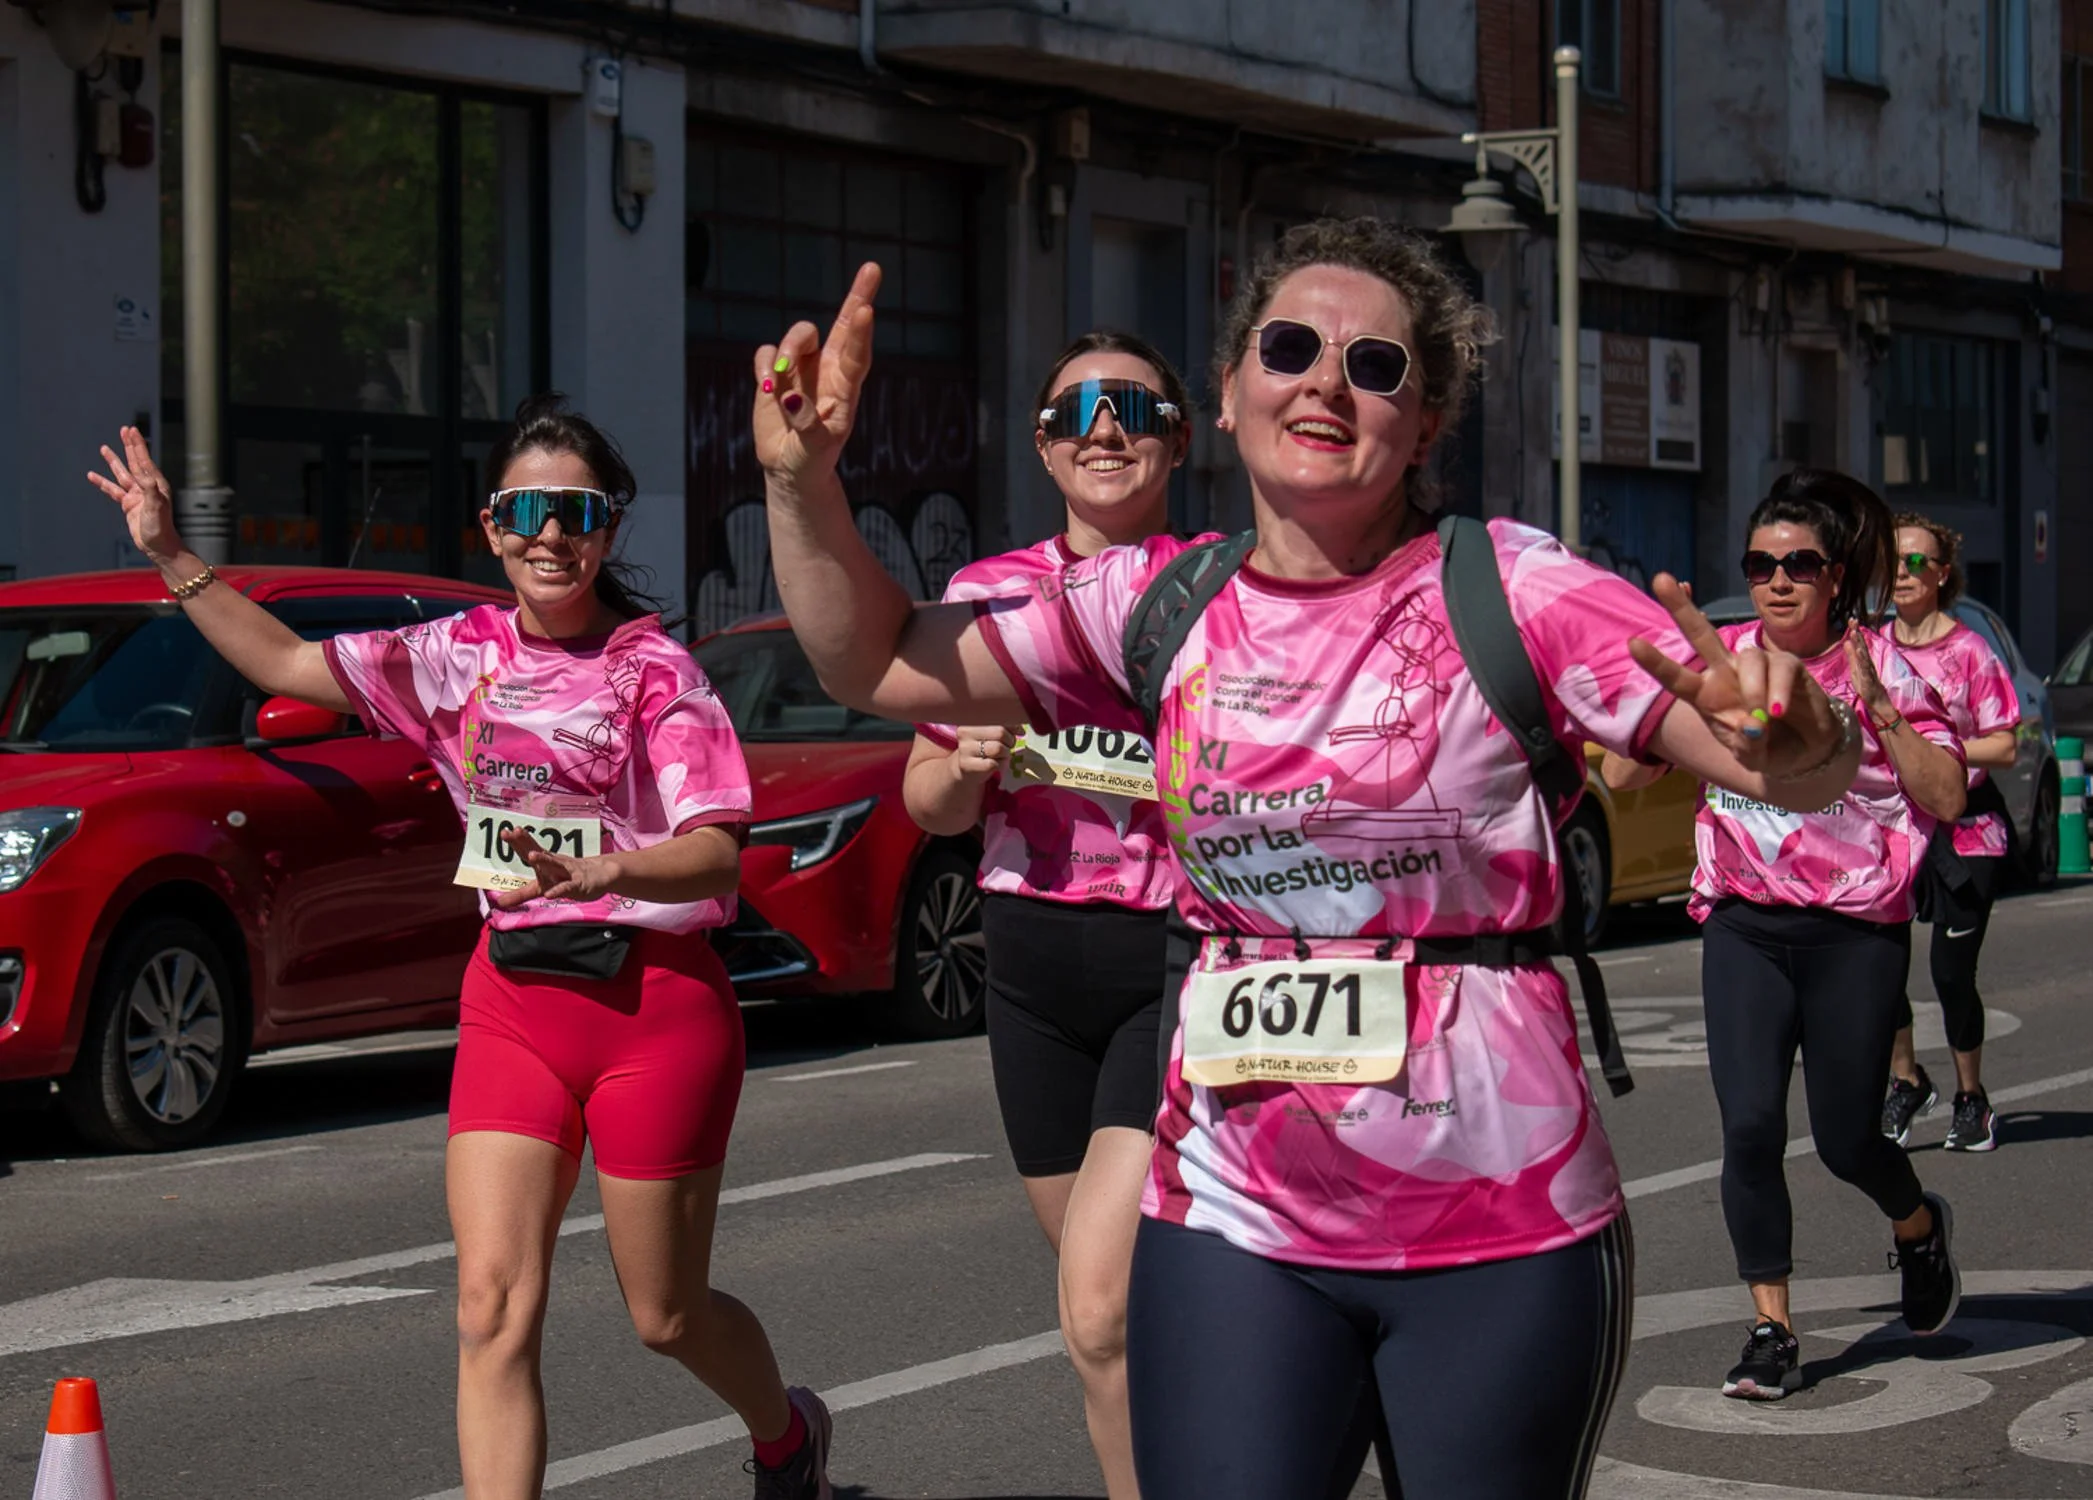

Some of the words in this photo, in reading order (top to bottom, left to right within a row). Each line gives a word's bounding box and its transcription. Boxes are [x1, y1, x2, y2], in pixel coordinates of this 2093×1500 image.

[1215, 686, 1249, 698] contra
[1212, 698, 1225, 708] en
[1227, 699, 1240, 711] La
[1242, 700, 1270, 716] Rioja
[476, 721, 495, 745] XI
[1195, 736, 1229, 771] XI
[474, 753, 550, 784] Carrera
[1075, 771, 1107, 783] NATUR
[1108, 776, 1142, 789] HOUSE
[1188, 782, 1327, 817] Carrera
[1195, 833, 1262, 865] por
[1264, 824, 1304, 855] la
[1083, 853, 1095, 864] La
[1096, 853, 1121, 866] Rioja
[1212, 847, 1443, 899] Investigación
[1221, 971, 1361, 1037] 6671
[1247, 1058, 1293, 1072] NATUR
[1296, 1060, 1341, 1074] HOUSE
